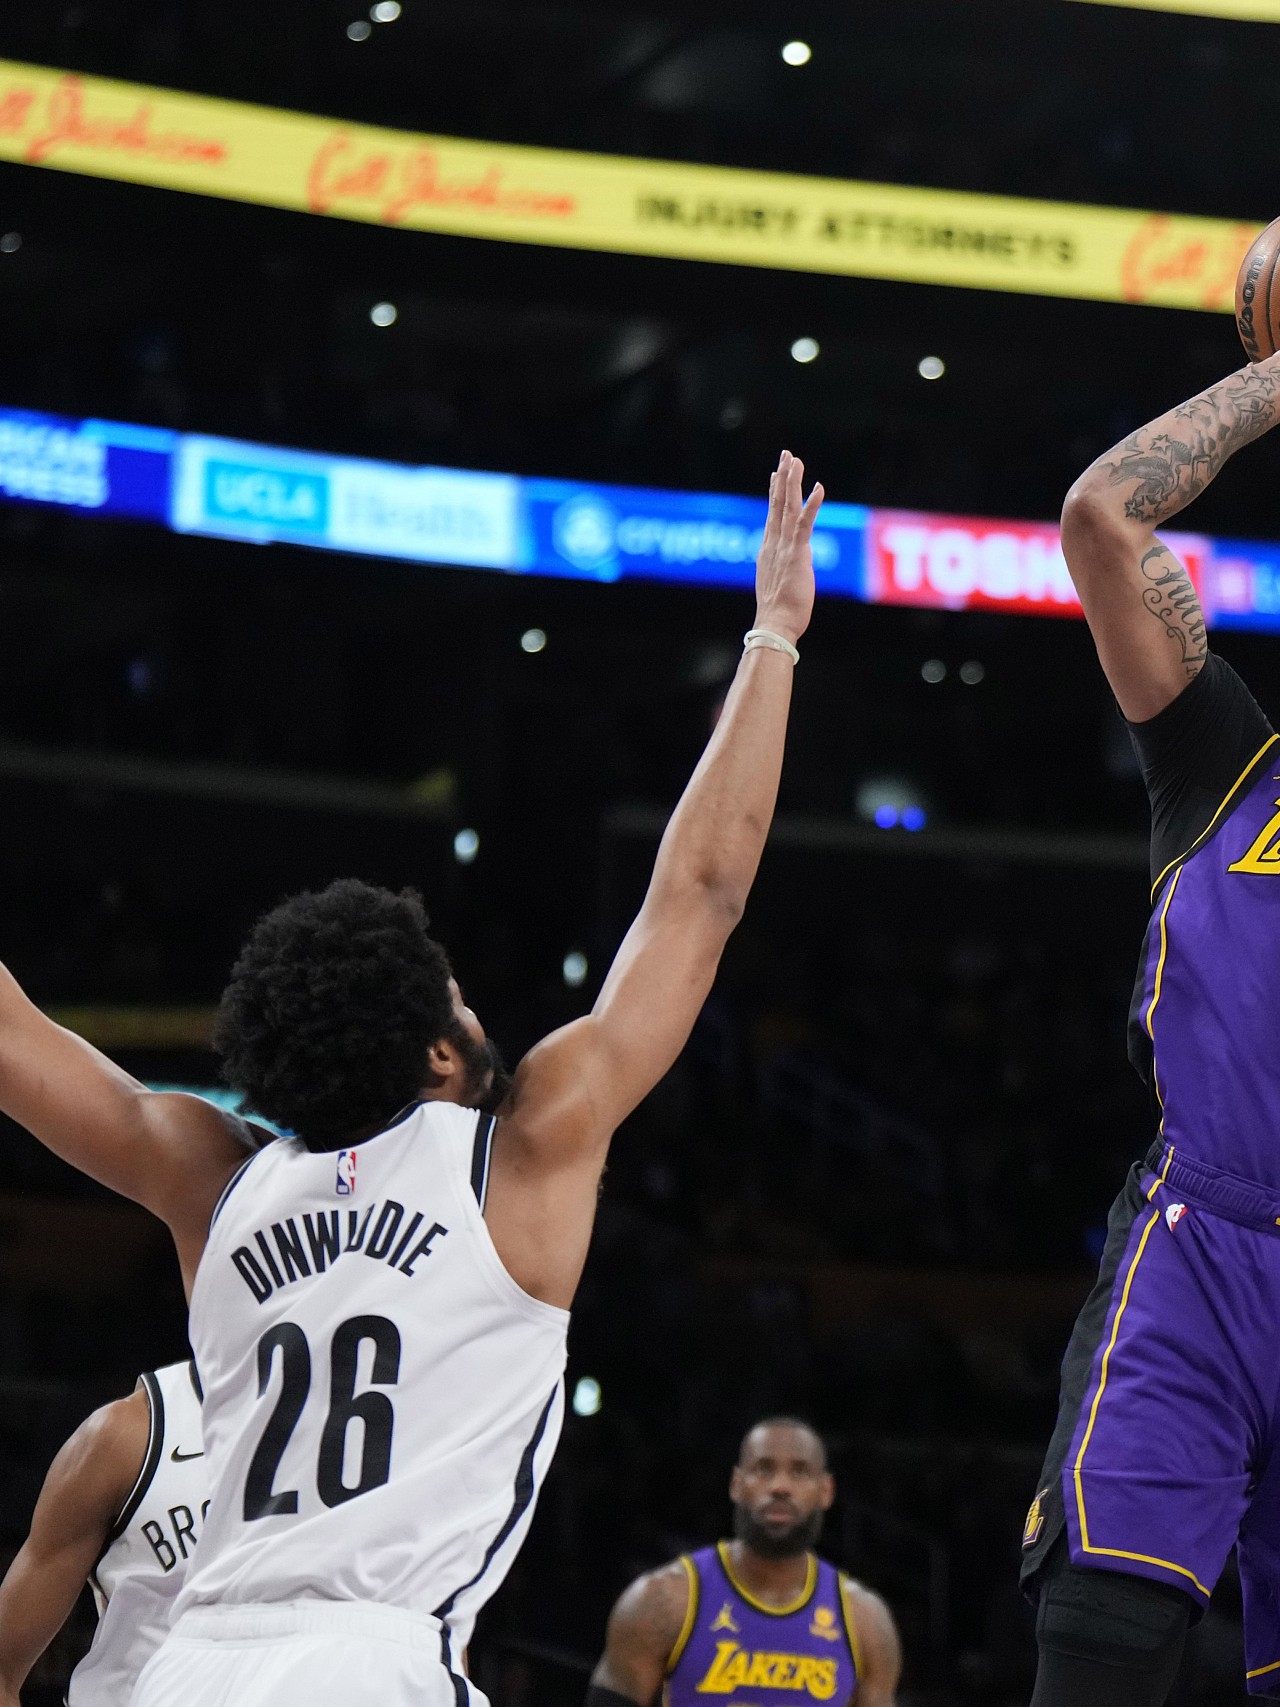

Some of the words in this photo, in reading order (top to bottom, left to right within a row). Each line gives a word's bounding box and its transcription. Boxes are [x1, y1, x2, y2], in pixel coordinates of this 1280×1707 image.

[635, 191, 801, 236] INJURY
[817, 211, 1078, 268] ATTORNEYS
[880, 524, 1082, 604] TOSH
[243, 1314, 401, 1521] 26
[696, 1640, 838, 1700] LAKERS
